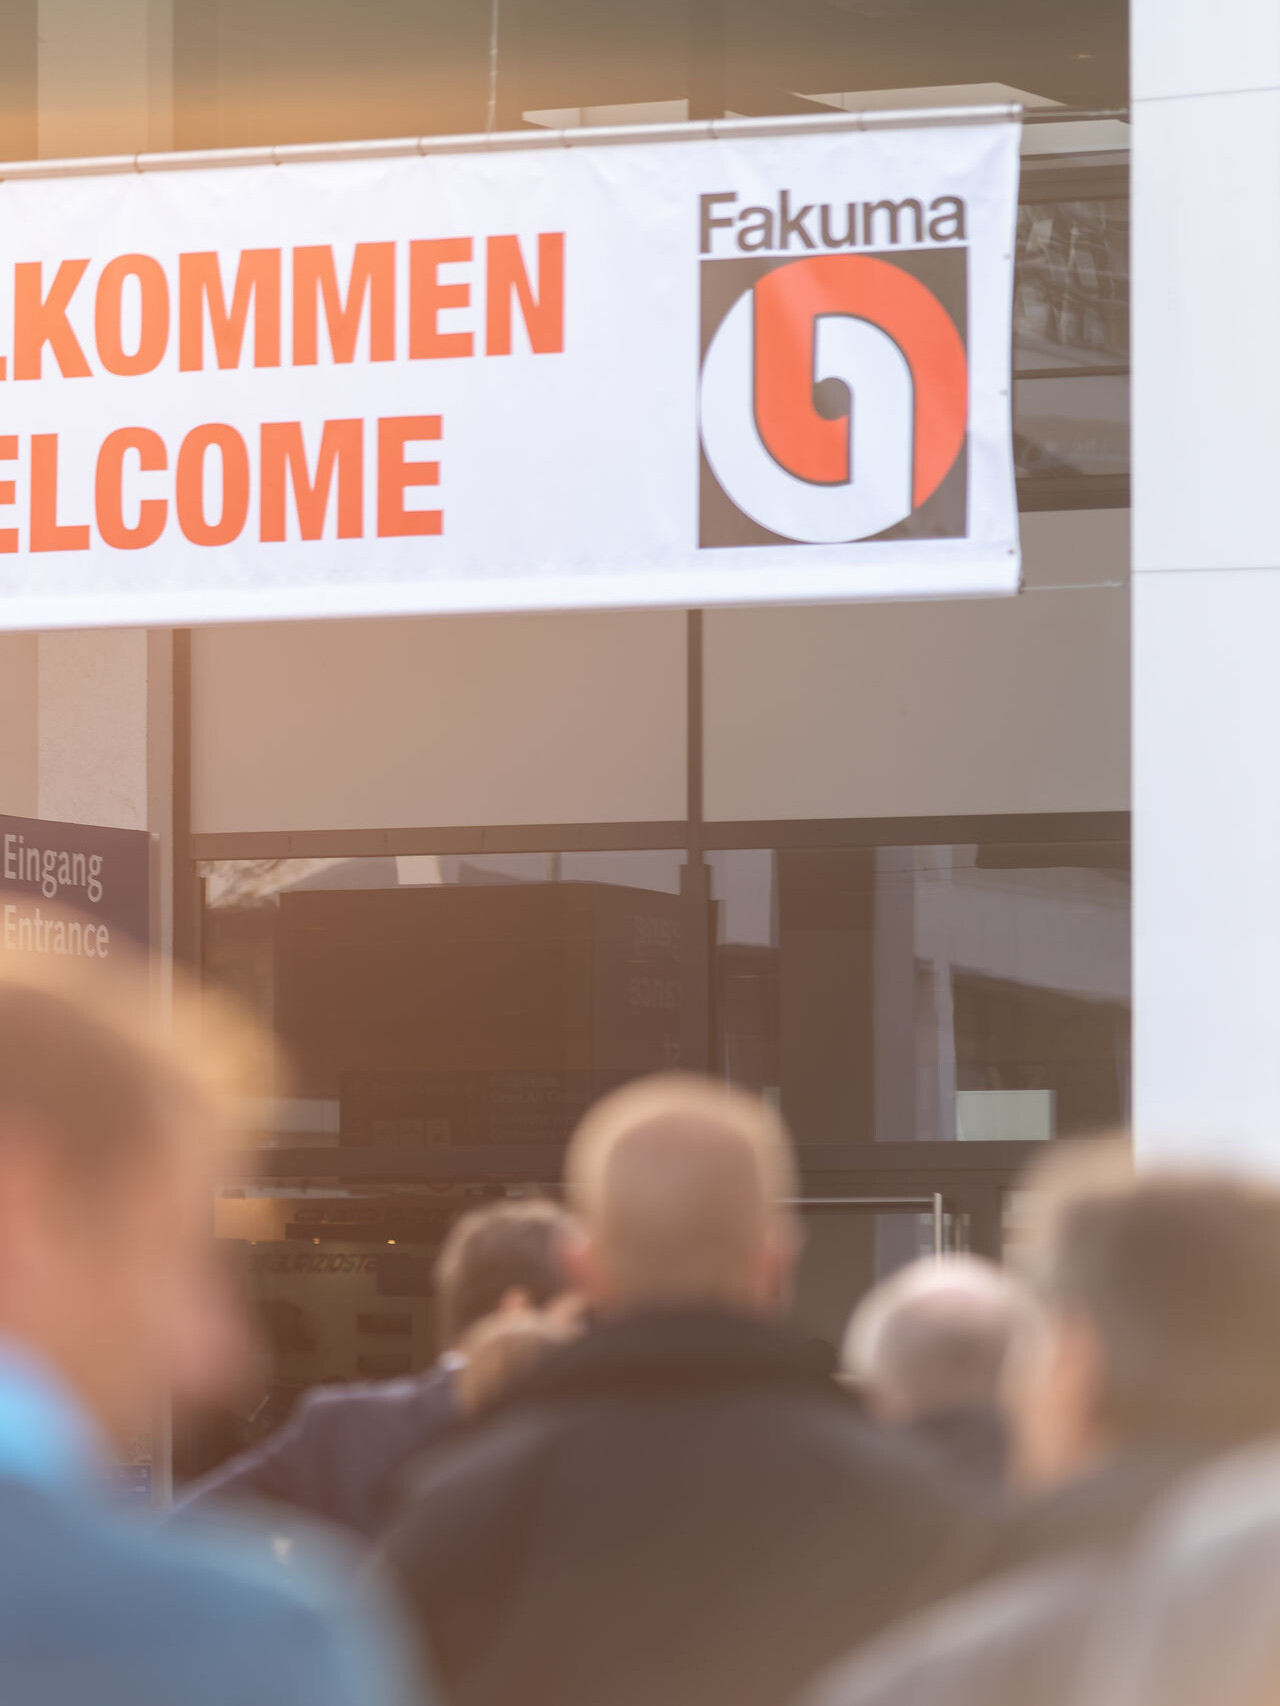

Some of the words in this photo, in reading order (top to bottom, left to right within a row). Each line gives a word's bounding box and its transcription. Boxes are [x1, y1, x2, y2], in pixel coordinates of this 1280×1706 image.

[699, 189, 967, 254] Fakuma
[4, 833, 103, 902] Eingang
[4, 904, 110, 958] Entrance
